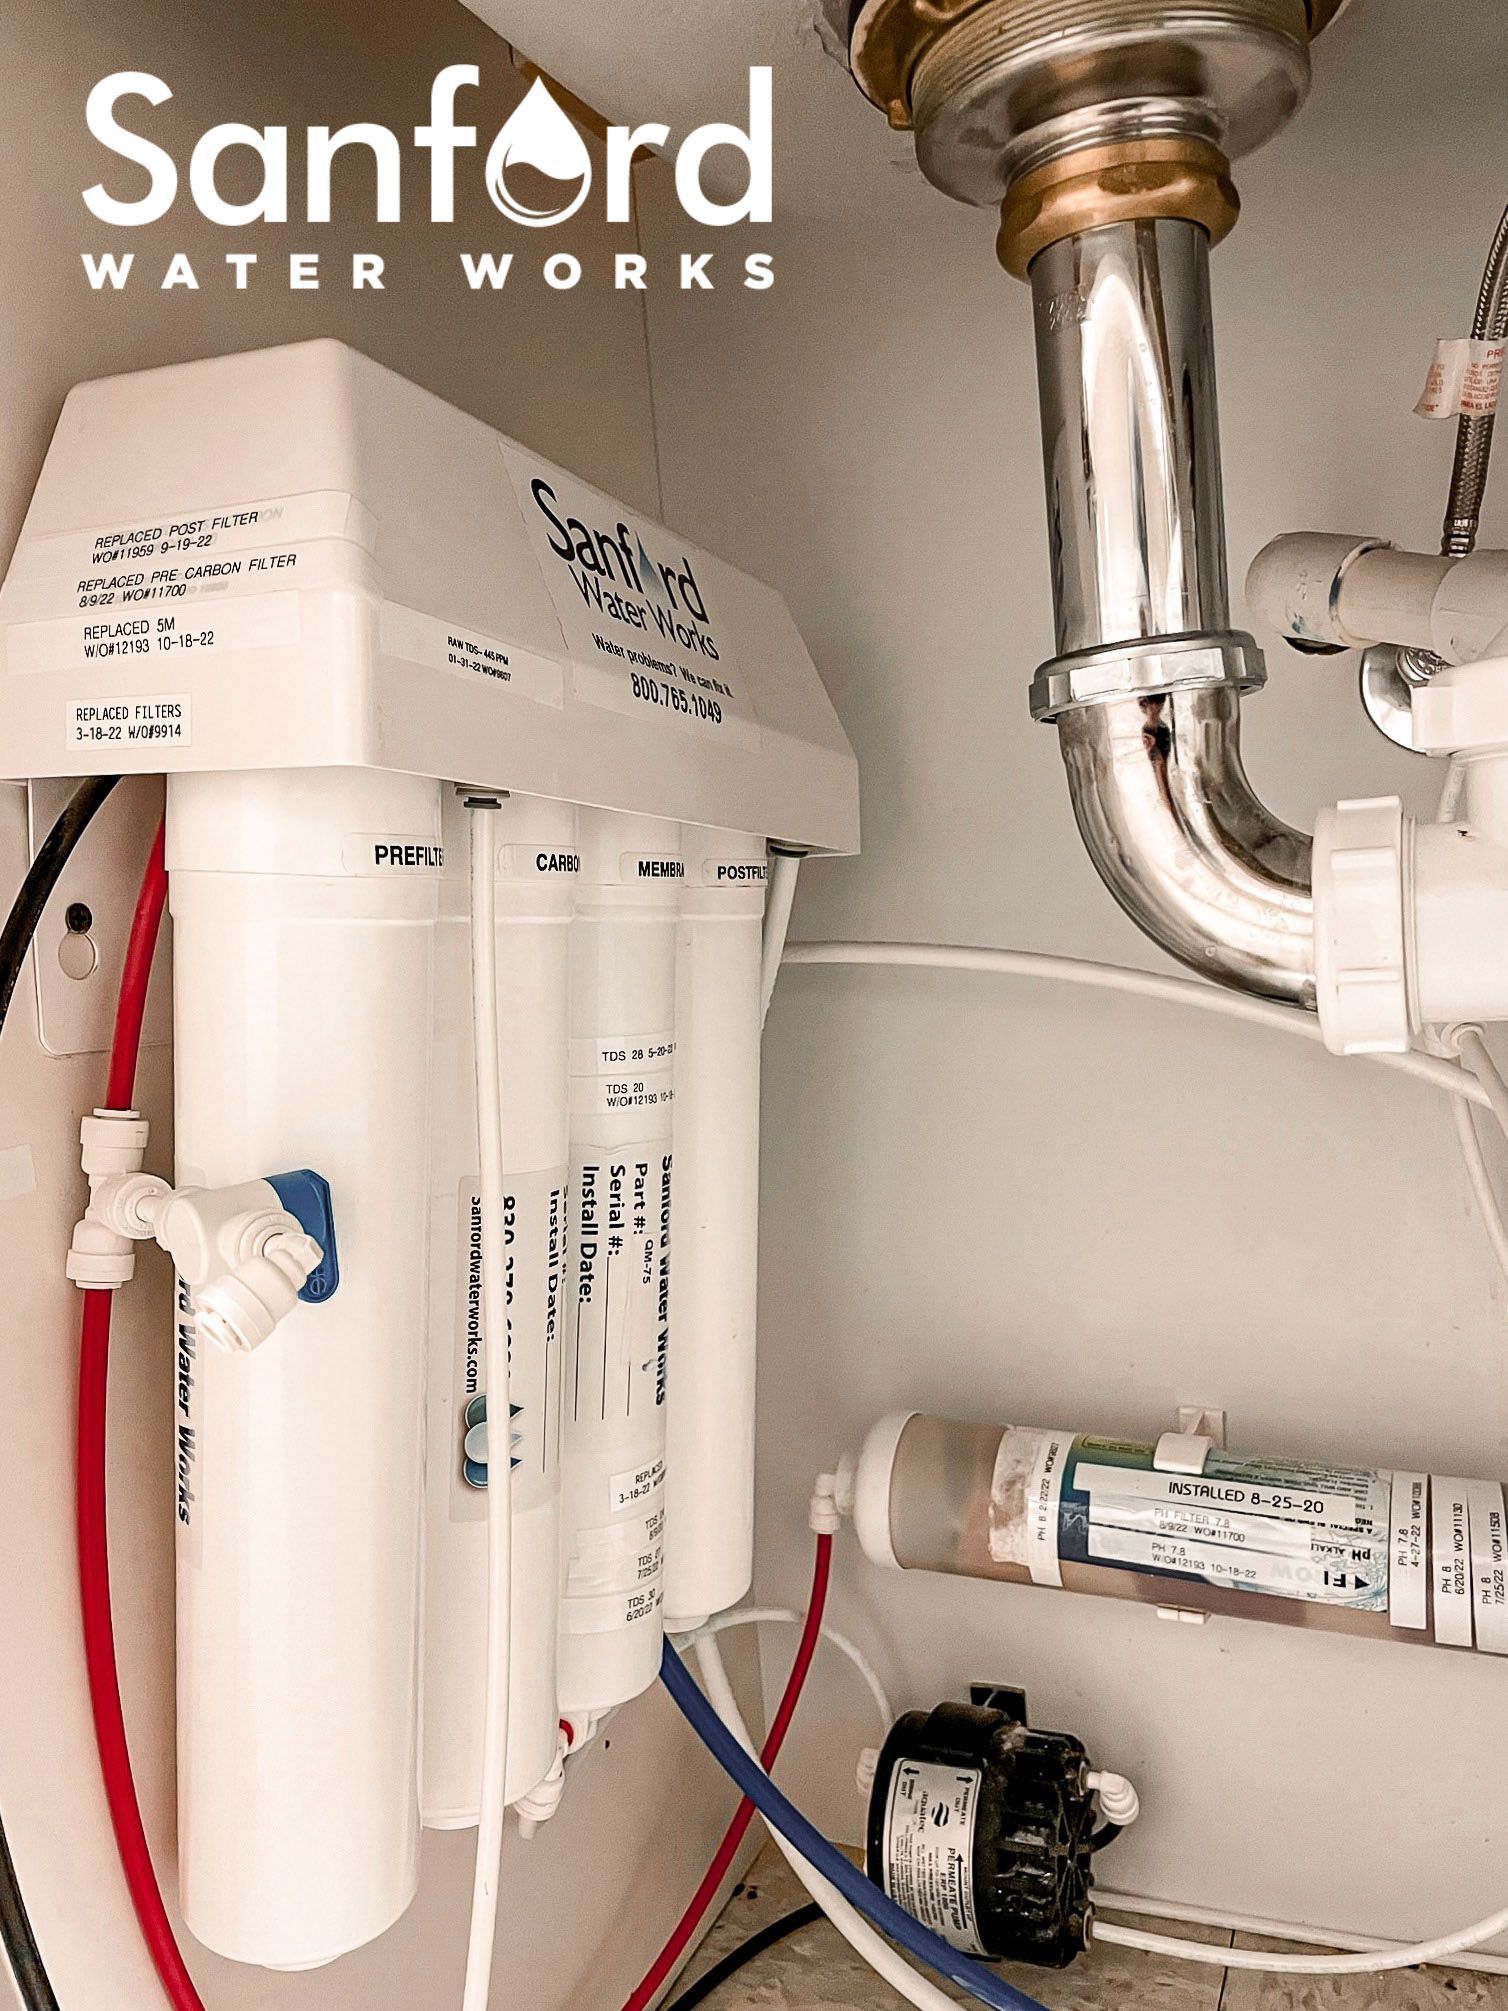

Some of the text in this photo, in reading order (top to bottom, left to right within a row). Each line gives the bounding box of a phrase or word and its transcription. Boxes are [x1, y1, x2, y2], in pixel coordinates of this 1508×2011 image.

[95, 527, 162, 549] REPLACED
[169, 520, 205, 537] POST
[211, 511, 259, 530] FILTER
[91, 534, 213, 564] WO#11959 9-19-22
[76, 553, 297, 593] REPLACED PRE CARBON FILTER
[78, 592, 114, 608] 8/9/22
[122, 584, 187, 603] WO#11700
[568, 564, 720, 661] Water Works
[84, 617, 175, 640] REPLACED 5M
[84, 631, 214, 659] W/O#12193 10-18-22
[448, 636, 463, 649] RAW
[449, 653, 481, 672] 01-31-22
[592, 632, 625, 658] Water
[627, 649, 677, 677] problems?
[679, 666, 696, 684] We
[630, 672, 721, 724] 800.765.1049
[76, 704, 182, 722] REPLACED FILTERS
[76, 723, 182, 741] 3-18-22 W/O#9914
[374, 845, 443, 867] PREFILTE
[536, 853, 580, 873] CARBO
[601, 1050, 626, 1062] TDS
[632, 1049, 644, 1060] 28
[606, 1082, 644, 1094] TDS 20
[606, 1093, 658, 1107] W/O#12193
[608, 1164, 626, 1256] Serial #:
[579, 1166, 600, 1303] Install Date:
[634, 1163, 654, 1285] Part #: QM-75
[546, 1189, 560, 1343] Install Date:
[658, 1252, 671, 1322] Water
[178, 1323, 196, 1418] Water
[178, 1424, 196, 1526] Works
[1169, 1481, 1324, 1514] INSTALLED 8-25-20
[1154, 1508, 1230, 1529] PH FILTER 7.8
[1037, 1527, 1046, 1541] PH
[1194, 1526, 1246, 1543] WO#11700
[1152, 1542, 1186, 1557] PH 7.8
[1352, 1549, 1371, 1561] pH
[1411, 1525, 1421, 1567] 4-27-22
[1398, 1551, 1407, 1567] PH
[1211, 1563, 1257, 1580] 10-18-22
[1455, 1558, 1465, 1595] 6/20/22
[1442, 1578, 1452, 1594] PH
[1482, 1590, 1492, 1605] PH
[1494, 1569, 1505, 1605] 7/25/22
[627, 1595, 645, 1609] TDS
[948, 1847, 958, 1905] PERMEATE
